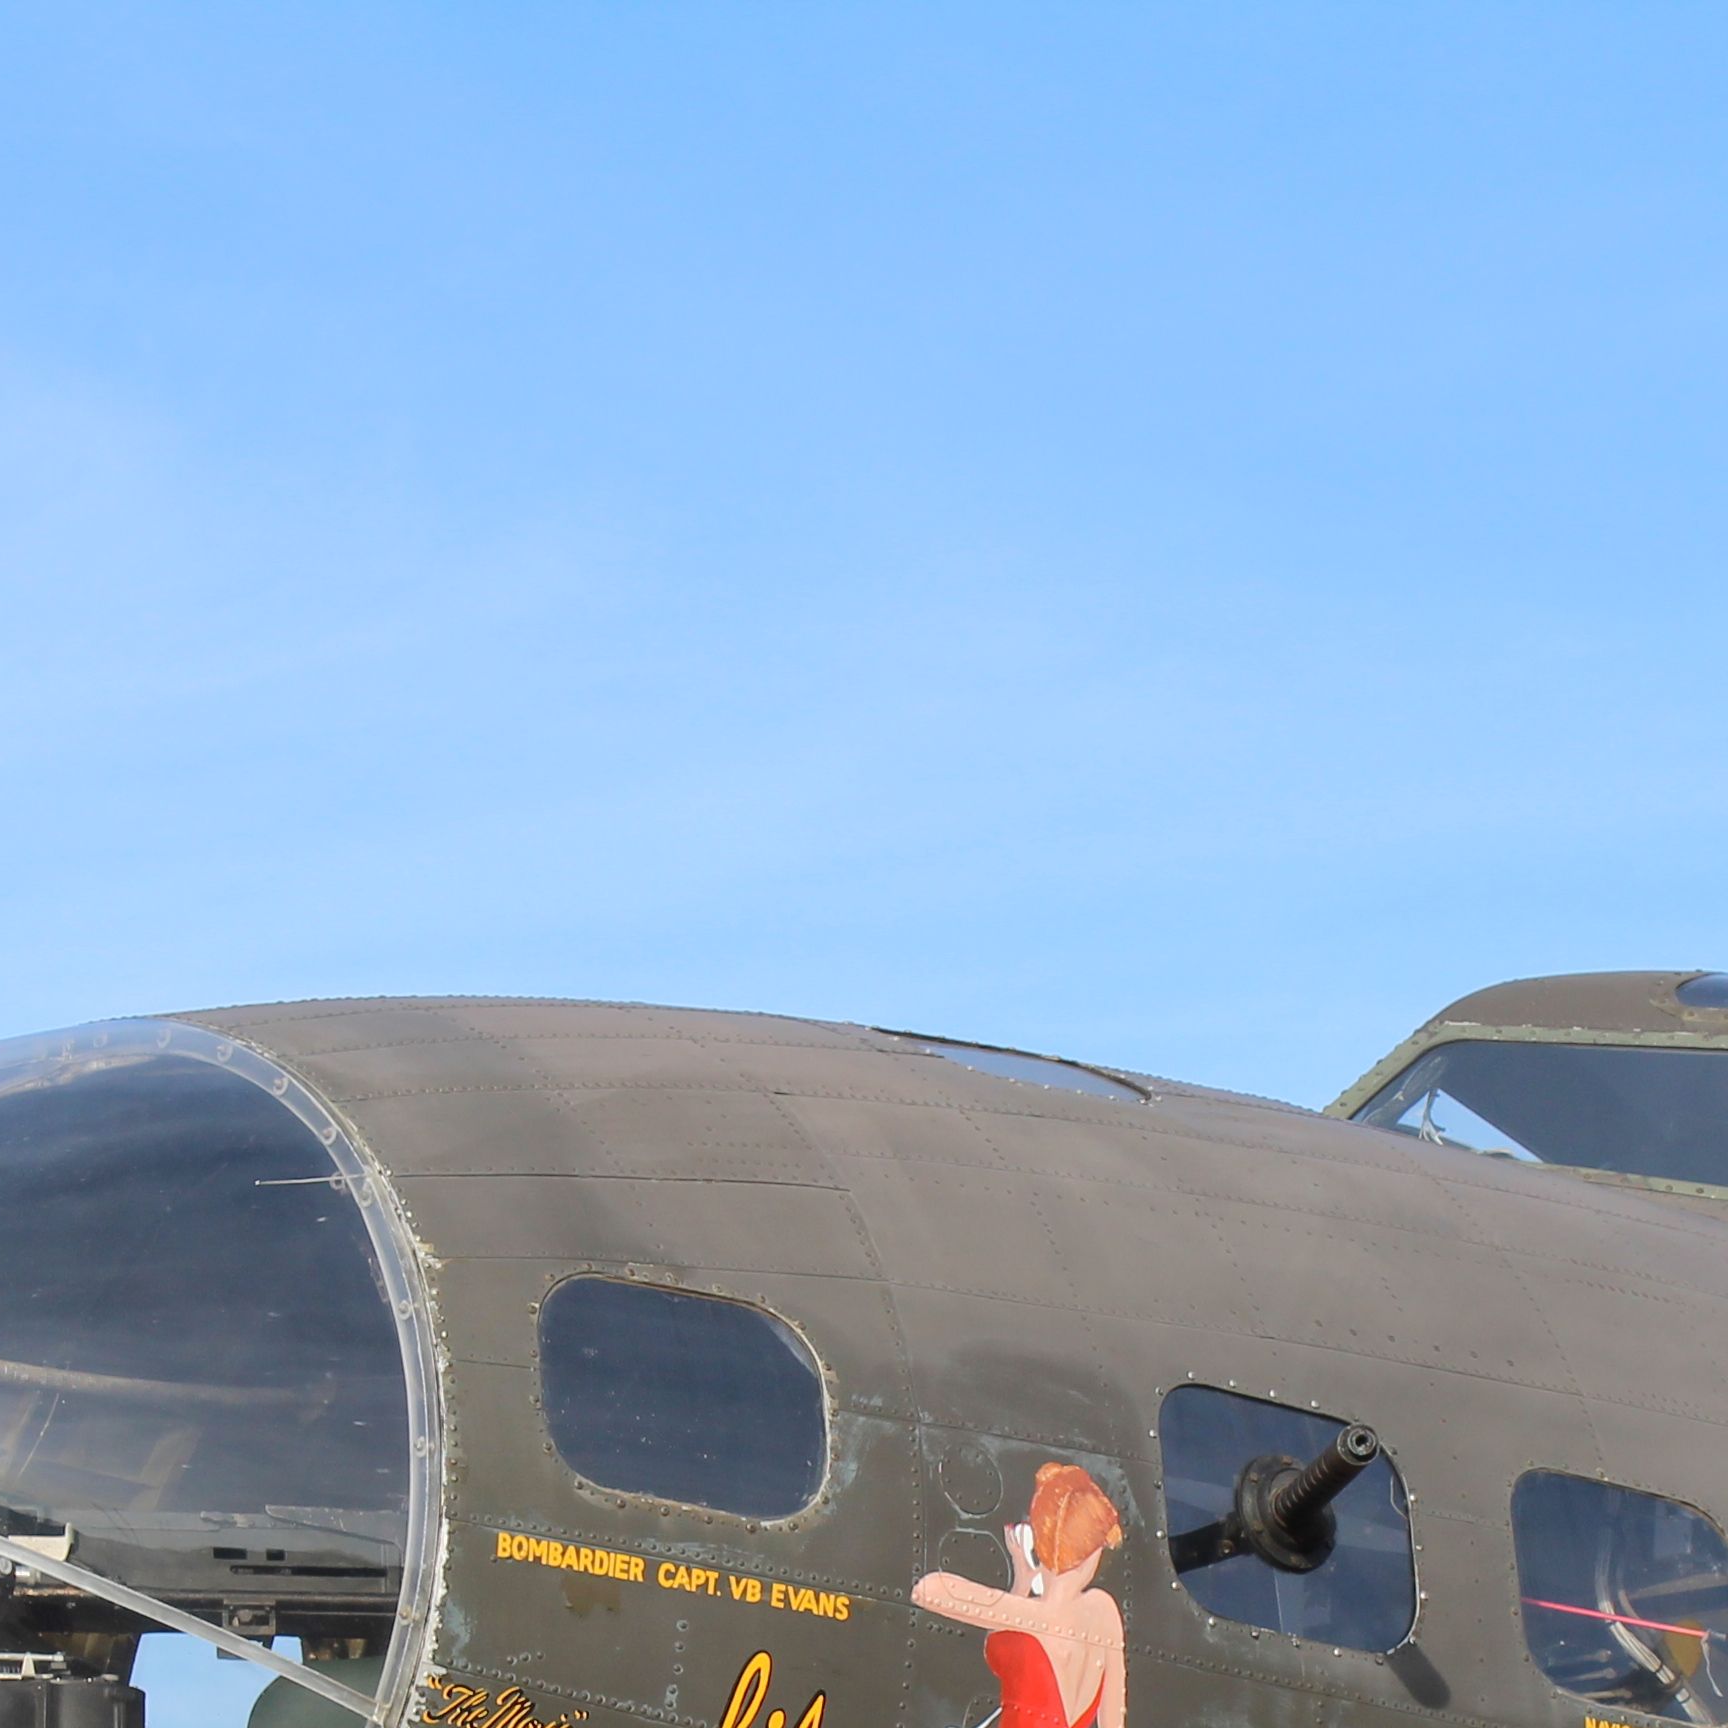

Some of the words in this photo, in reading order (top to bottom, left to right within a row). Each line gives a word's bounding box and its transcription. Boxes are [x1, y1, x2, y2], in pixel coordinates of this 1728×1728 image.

[496, 1531, 644, 1582] BOMBARDIER
[657, 1562, 722, 1597] CAPT.
[728, 1575, 762, 1604] VB
[770, 1583, 852, 1621] EVANS
